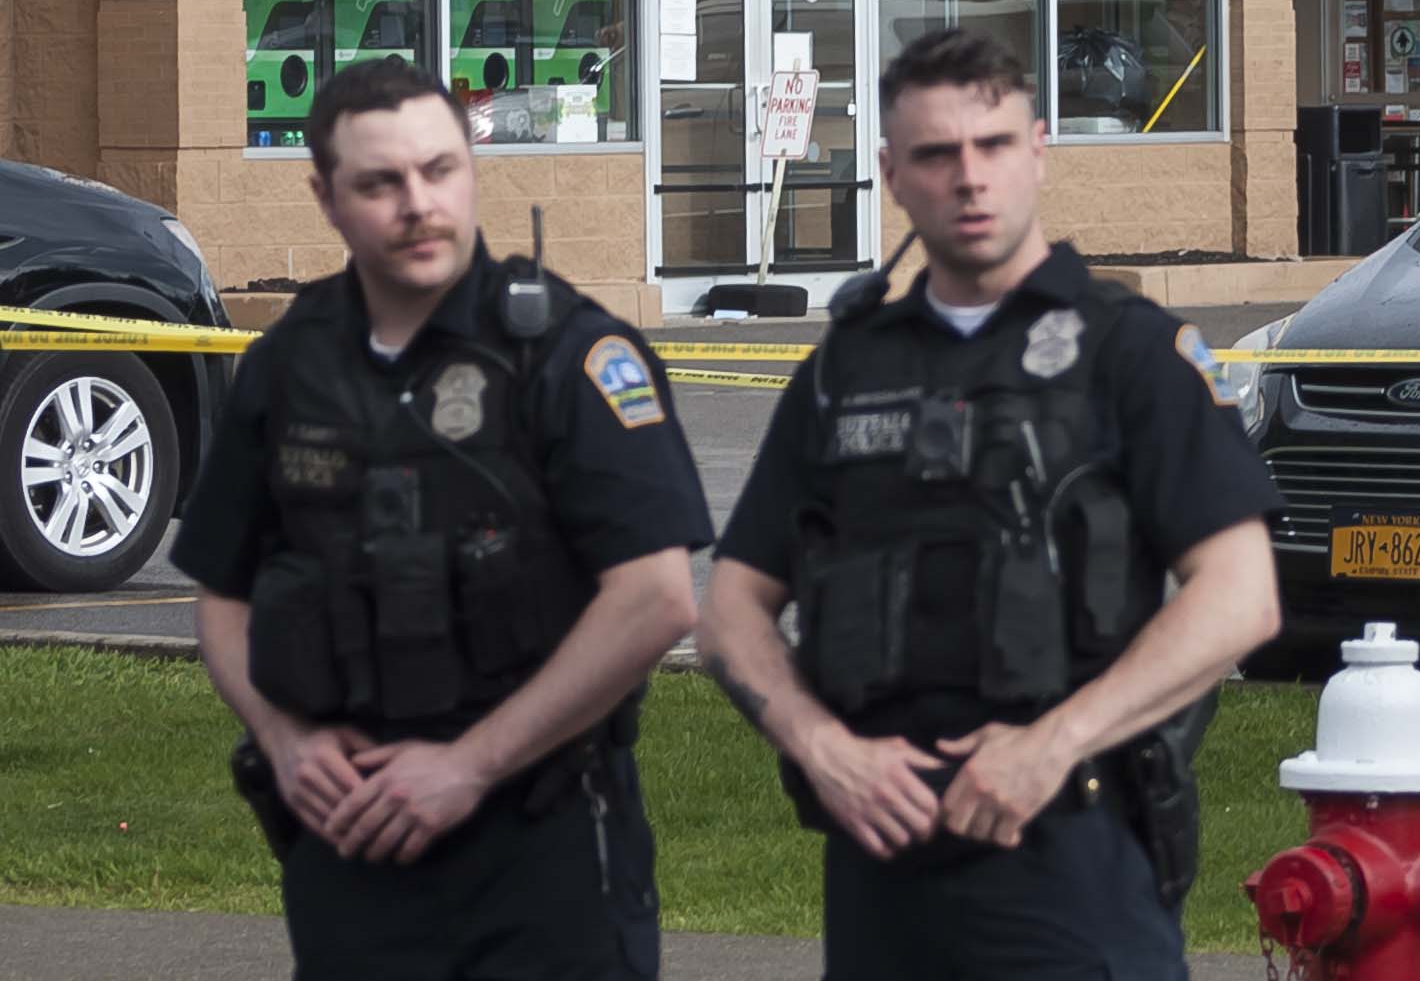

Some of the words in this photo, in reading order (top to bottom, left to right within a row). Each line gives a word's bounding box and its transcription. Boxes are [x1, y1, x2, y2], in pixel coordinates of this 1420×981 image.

[785, 78, 804, 96] NO
[770, 98, 811, 114] PARKING
[778, 115, 798, 127] FIRE
[775, 128, 798, 140] LANE
[1361, 515, 1389, 525] NEW
[1391, 516, 1420, 526] YORK
